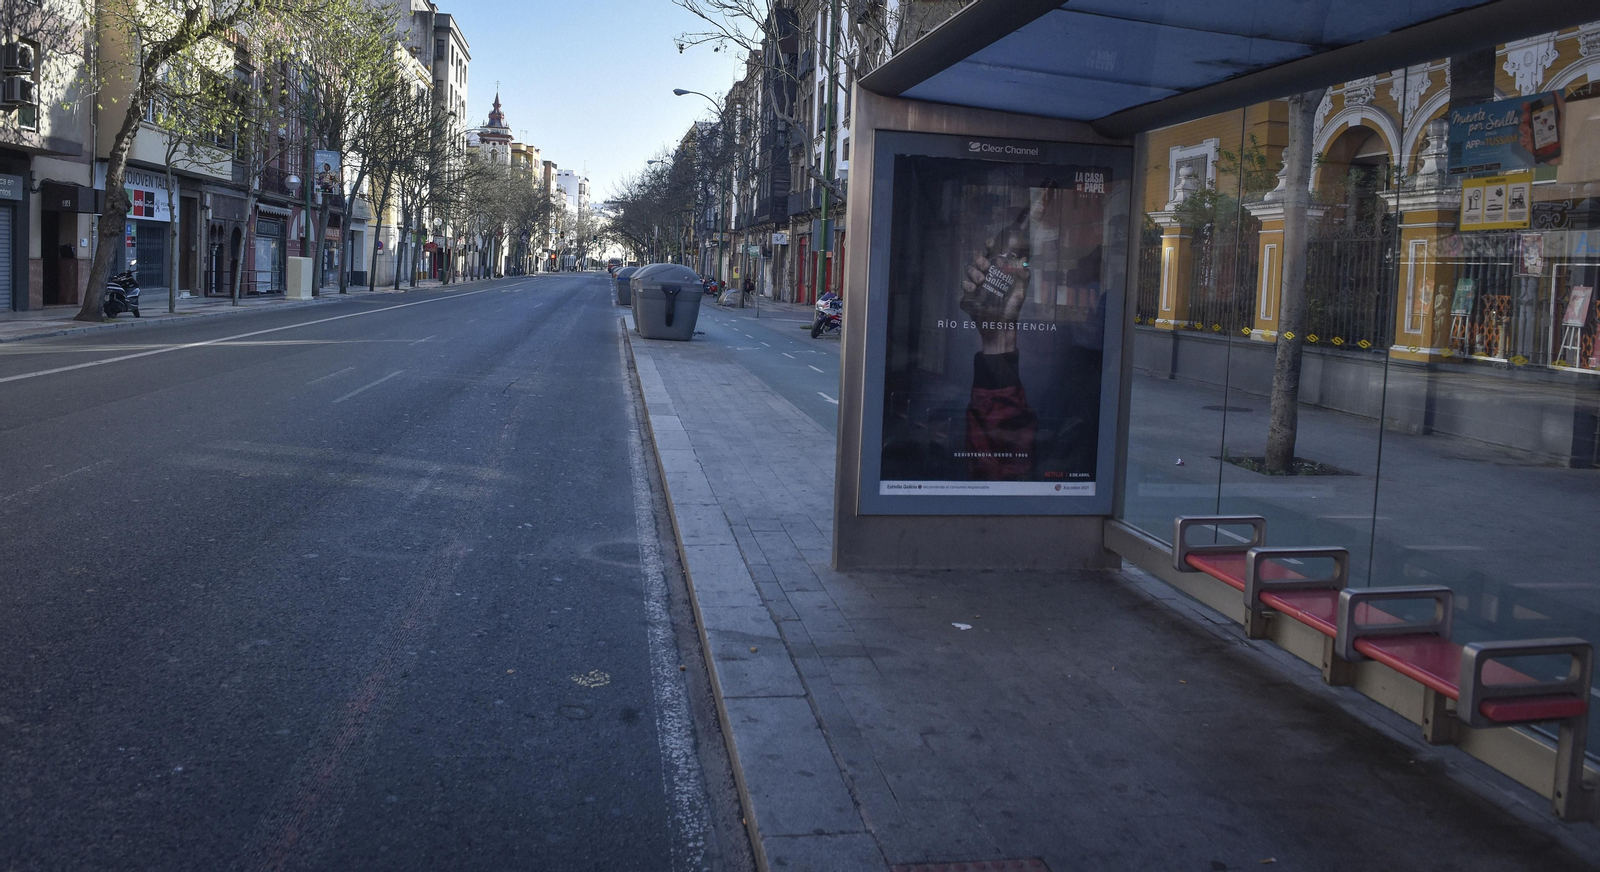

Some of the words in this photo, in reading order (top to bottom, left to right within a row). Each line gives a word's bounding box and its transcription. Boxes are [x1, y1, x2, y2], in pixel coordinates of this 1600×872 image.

[1468, 122, 1484, 137] por
[1485, 110, 1520, 130] Sevilla
[1466, 140, 1481, 149] APP
[1486, 134, 1518, 147] TUSSAM
[981, 143, 1004, 153] Clear
[1005, 145, 1039, 156] Channel
[124, 170, 154, 188] TOJOVEN
[1075, 172, 1084, 182] LA
[1085, 172, 1104, 183] CASA
[1085, 183, 1106, 194] PAPEL
[988, 264, 1015, 286] Estrella
[985, 273, 1009, 293] Galicia
[938, 319, 958, 329] RÍO
[963, 321, 977, 330] ES
[982, 321, 1057, 331] RESISTENCIA
